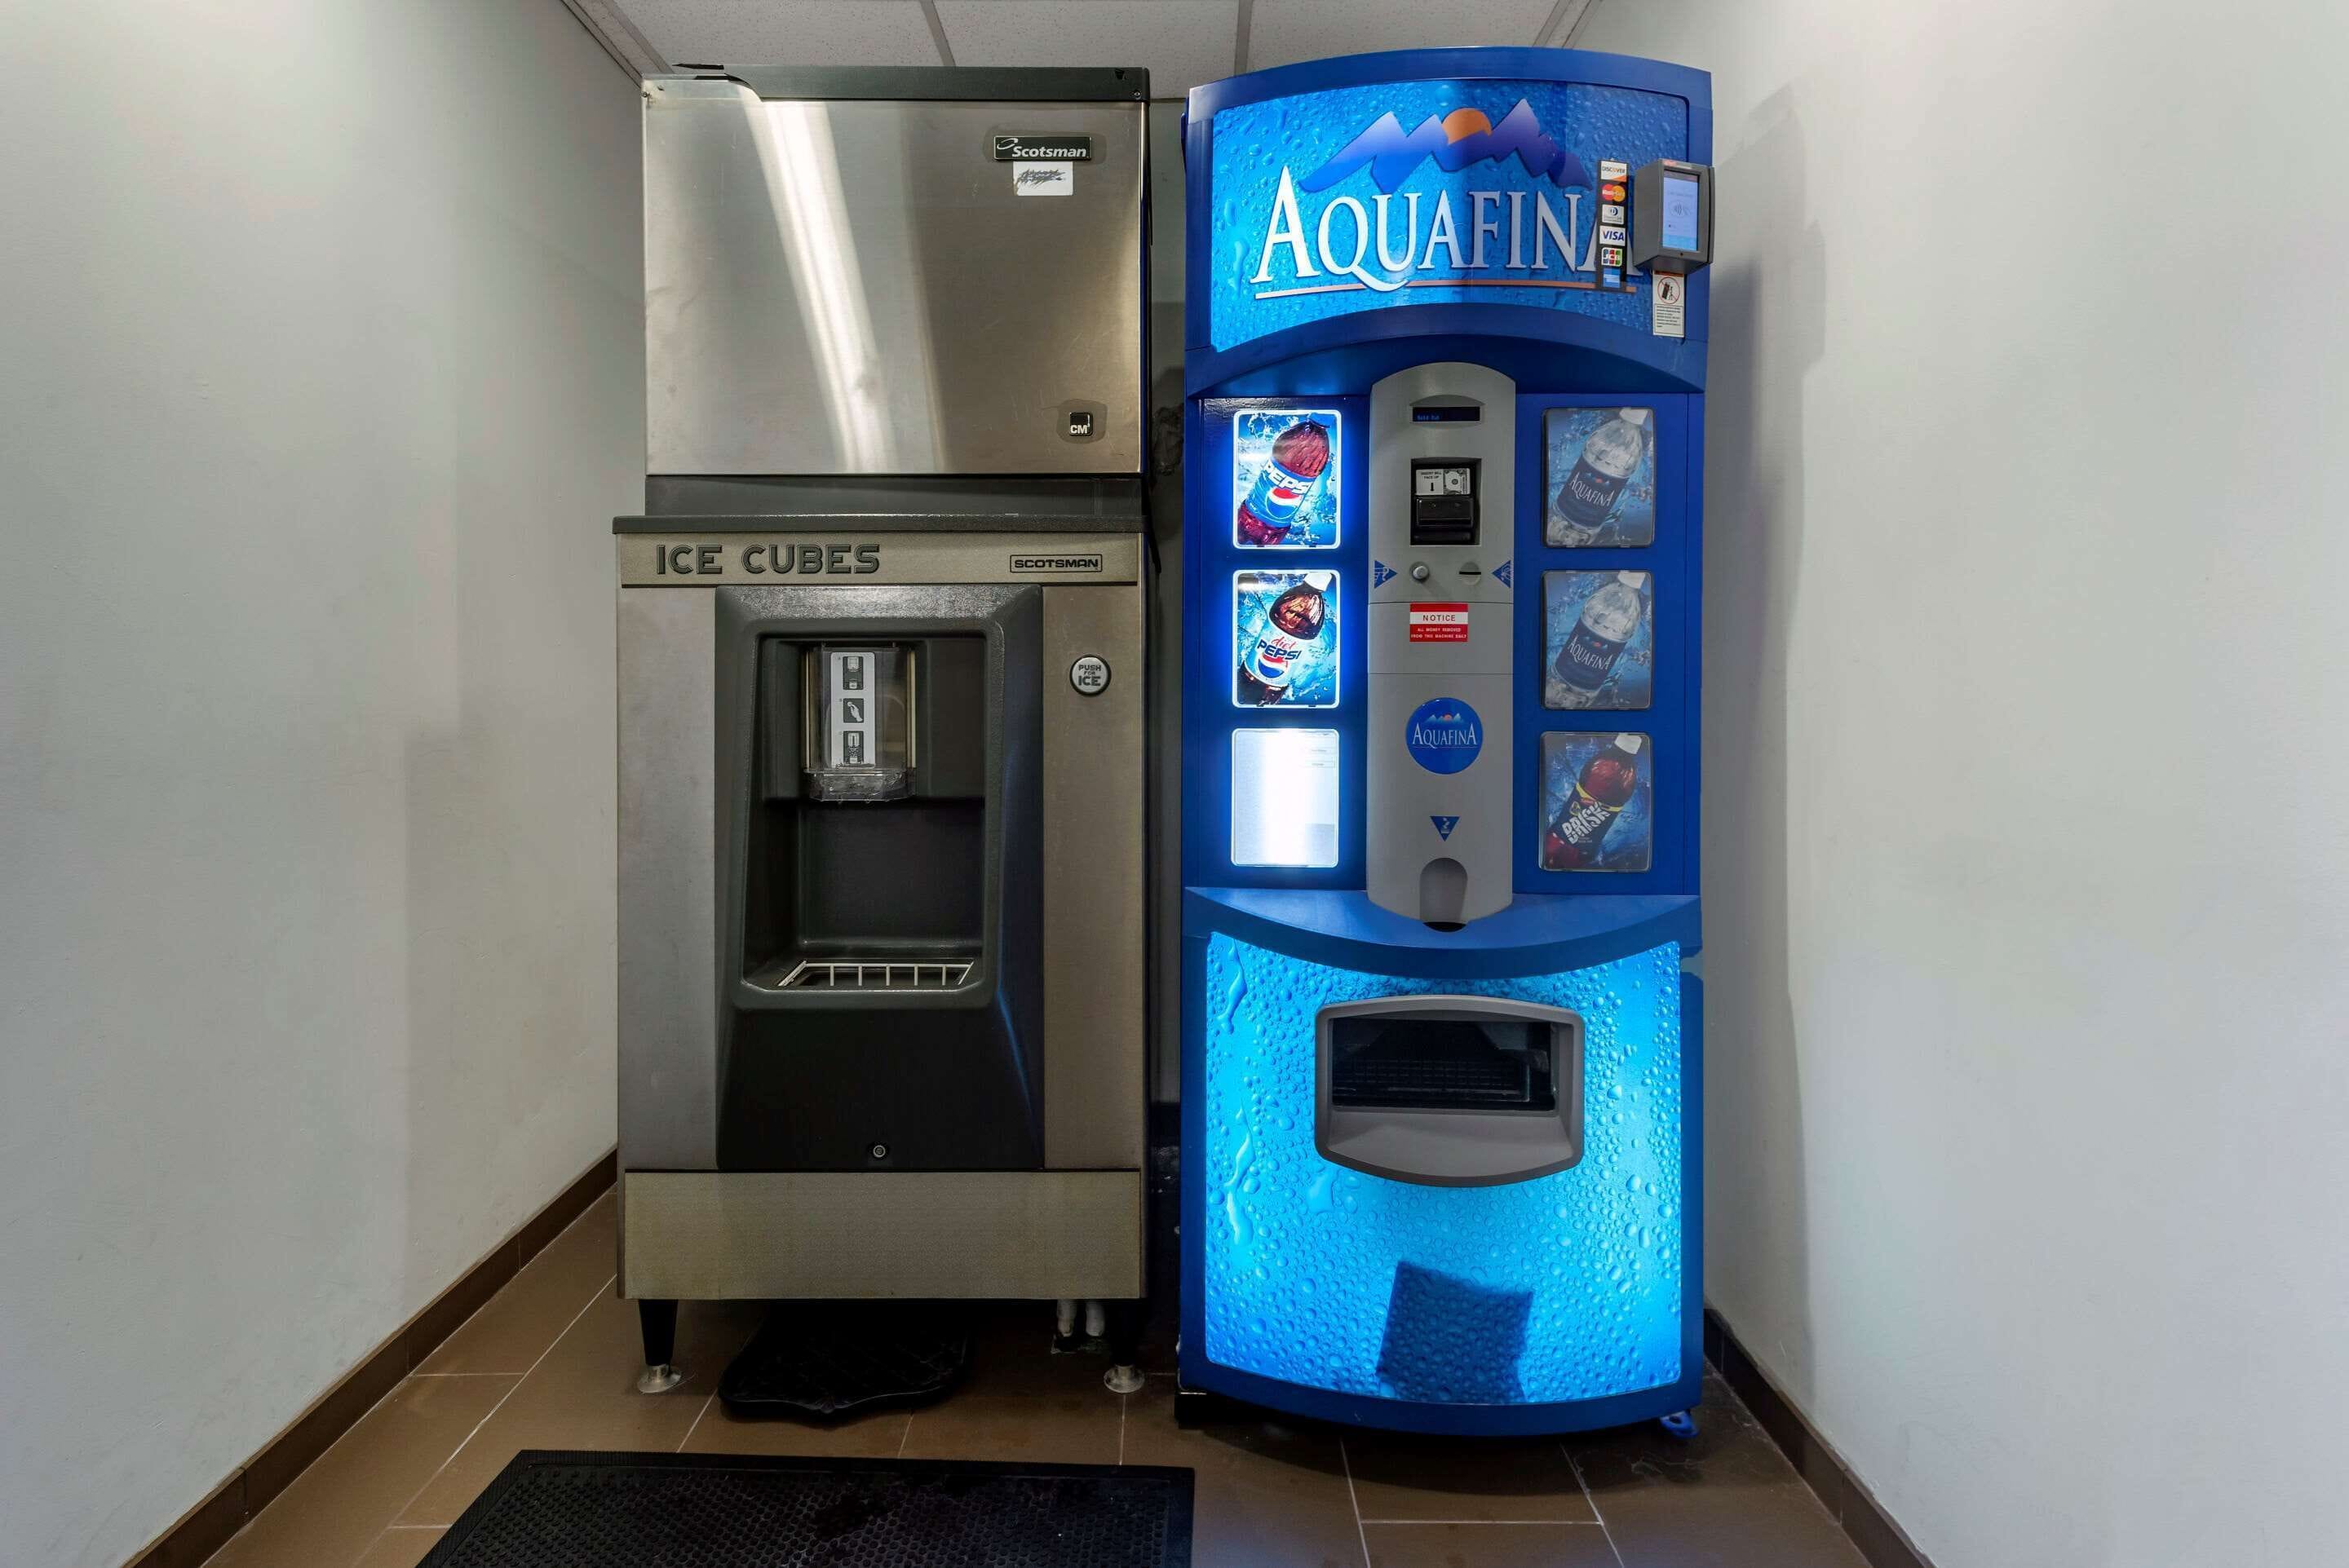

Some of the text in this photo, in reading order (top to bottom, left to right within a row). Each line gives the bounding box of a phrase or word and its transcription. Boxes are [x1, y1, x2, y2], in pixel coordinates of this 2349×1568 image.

[1011, 146, 1087, 157] Scotsman
[1603, 230, 1625, 241] VISA
[1569, 471, 1615, 506] AQUAFINA
[657, 544, 880, 575] ICE CUBES
[1014, 559, 1099, 568] SCOTSMAN
[1256, 638, 1303, 660] PEPSI
[1567, 635, 1613, 670] AQUAFINA
[1077, 675, 1101, 687] ICE
[1412, 722, 1478, 749] AQUAFINA
[1562, 801, 1611, 845] BRISK
